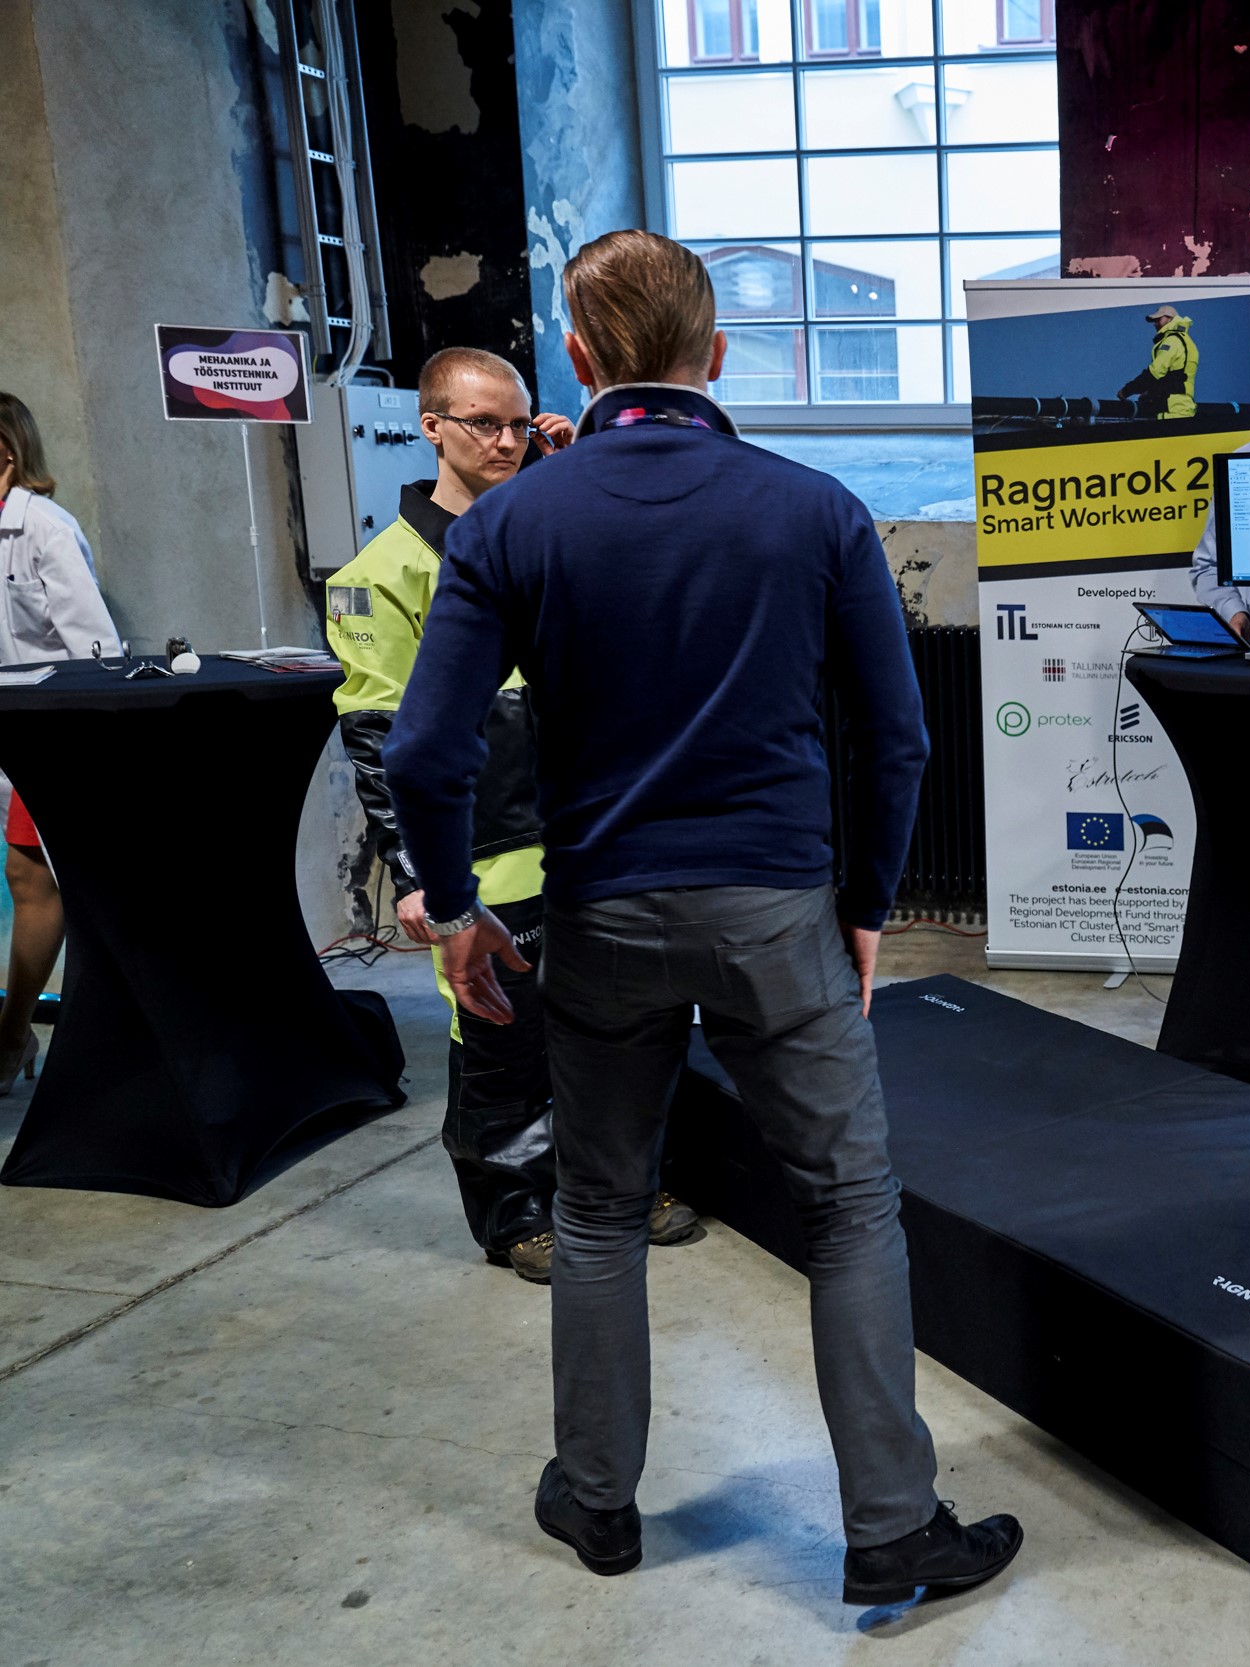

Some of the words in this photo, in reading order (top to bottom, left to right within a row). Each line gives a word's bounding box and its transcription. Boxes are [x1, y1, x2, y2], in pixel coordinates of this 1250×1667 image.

[199, 355, 257, 366] MEHAANIKA
[260, 358, 271, 367] JA
[193, 366, 278, 379] TÖÖSTUSTEHNIKA
[213, 381, 262, 391] INSTITUUT
[981, 460, 1176, 511] Ragnarok
[1187, 457, 1214, 490] 2
[983, 511, 1054, 534] Smart
[1060, 504, 1187, 528] Workwear
[1194, 498, 1212, 518] P
[1078, 587, 1136, 598] Developed
[1139, 587, 1156, 598] by:
[1071, 662, 1114, 671] TALLINNA
[1037, 713, 1092, 728] protex
[1108, 735, 1153, 743] ERICSSON
[1052, 883, 1106, 893] estonia.ee
[1009, 894, 1029, 903] The
[1031, 894, 1066, 906] project
[1068, 896, 1087, 904] has
[1089, 896, 1115, 906] been
[1117, 898, 1170, 908] supported
[1172, 898, 1185, 909] by
[1009, 906, 1053, 918] Regional
[1055, 907, 1122, 919] Development
[1125, 910, 1151, 919] Fund
[1153, 910, 1186, 922] throug
[1009, 918, 1057, 928] “Estonian
[1060, 920, 1077, 929] ICT
[1122, 922, 1141, 931] and
[1070, 932, 1106, 942] Cluster
